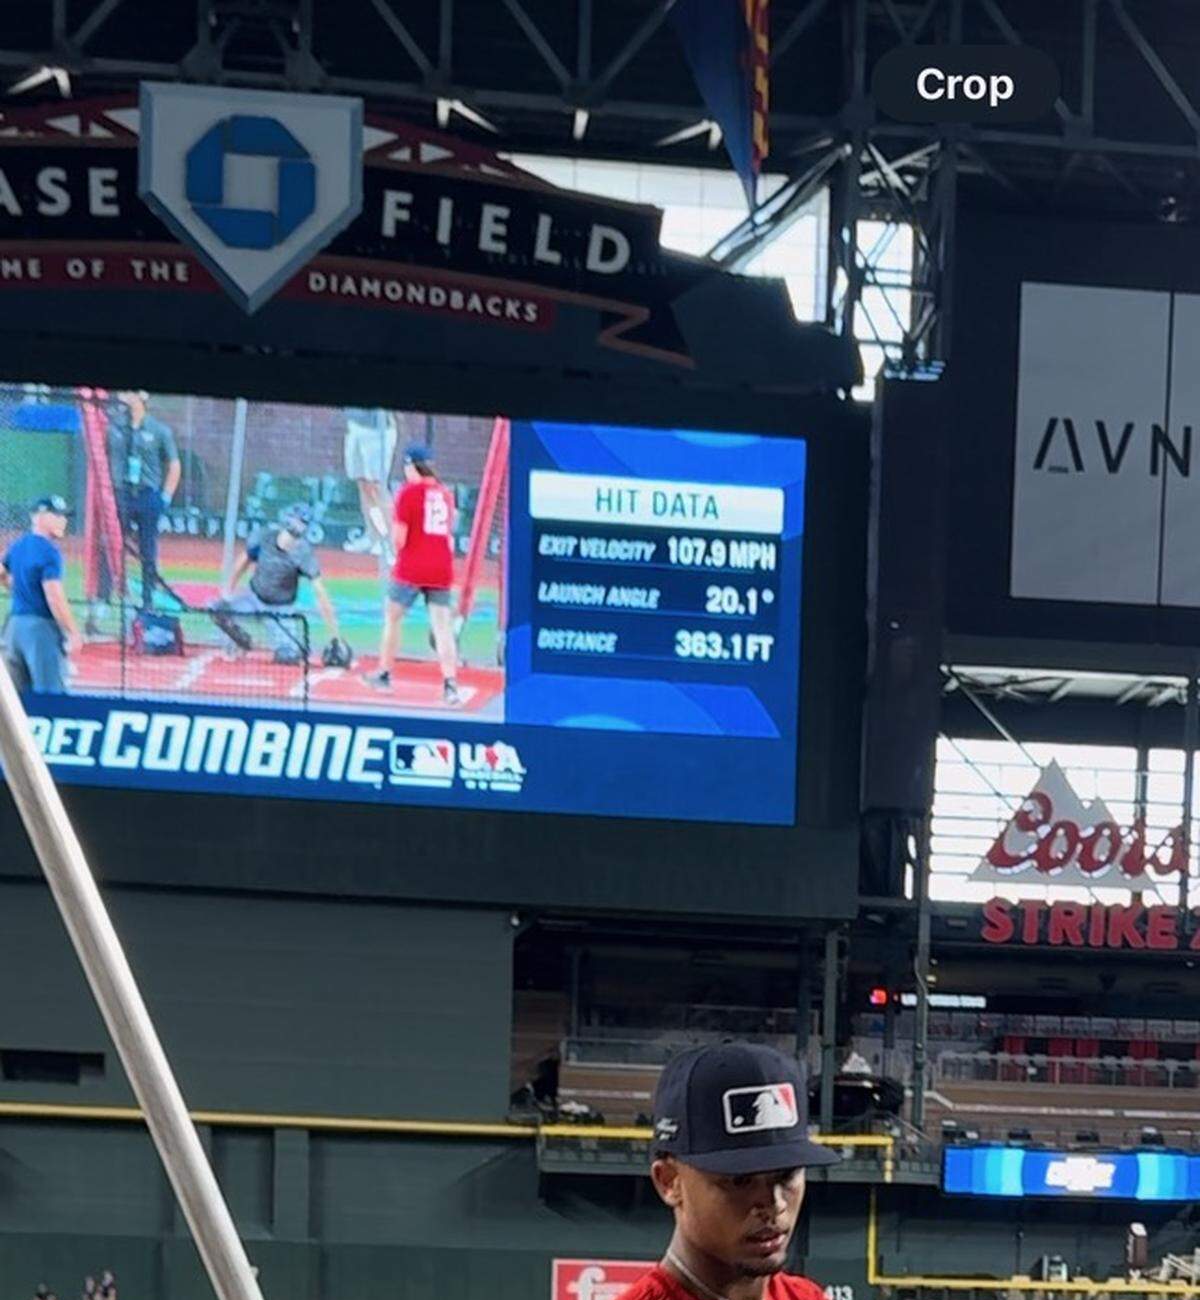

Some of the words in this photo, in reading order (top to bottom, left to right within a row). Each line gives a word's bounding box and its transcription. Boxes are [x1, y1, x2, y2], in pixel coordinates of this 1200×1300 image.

[381, 189, 631, 274] FIELD
[0, 258, 42, 279] ME
[66, 258, 104, 279] OF
[131, 259, 190, 282] THE
[308, 272, 538, 322] DIAMONDBACKS
[1033, 416, 1192, 478] AVN
[595, 487, 640, 514] HIT
[652, 490, 719, 520] DATA
[539, 534, 577, 557] EXIT
[580, 537, 656, 562] VELOCITY
[668, 536, 726, 568] 107.9
[729, 540, 776, 571] MPH
[538, 582, 605, 606] LAUNCH
[606, 586, 660, 609] ANGLE
[537, 628, 618, 653] DISTANCE
[675, 630, 742, 660] 363.1
[746, 634, 774, 662] FT
[100, 709, 394, 783] COMBINE
[987, 792, 1187, 876] Coors
[981, 897, 1178, 949] STRIKE
